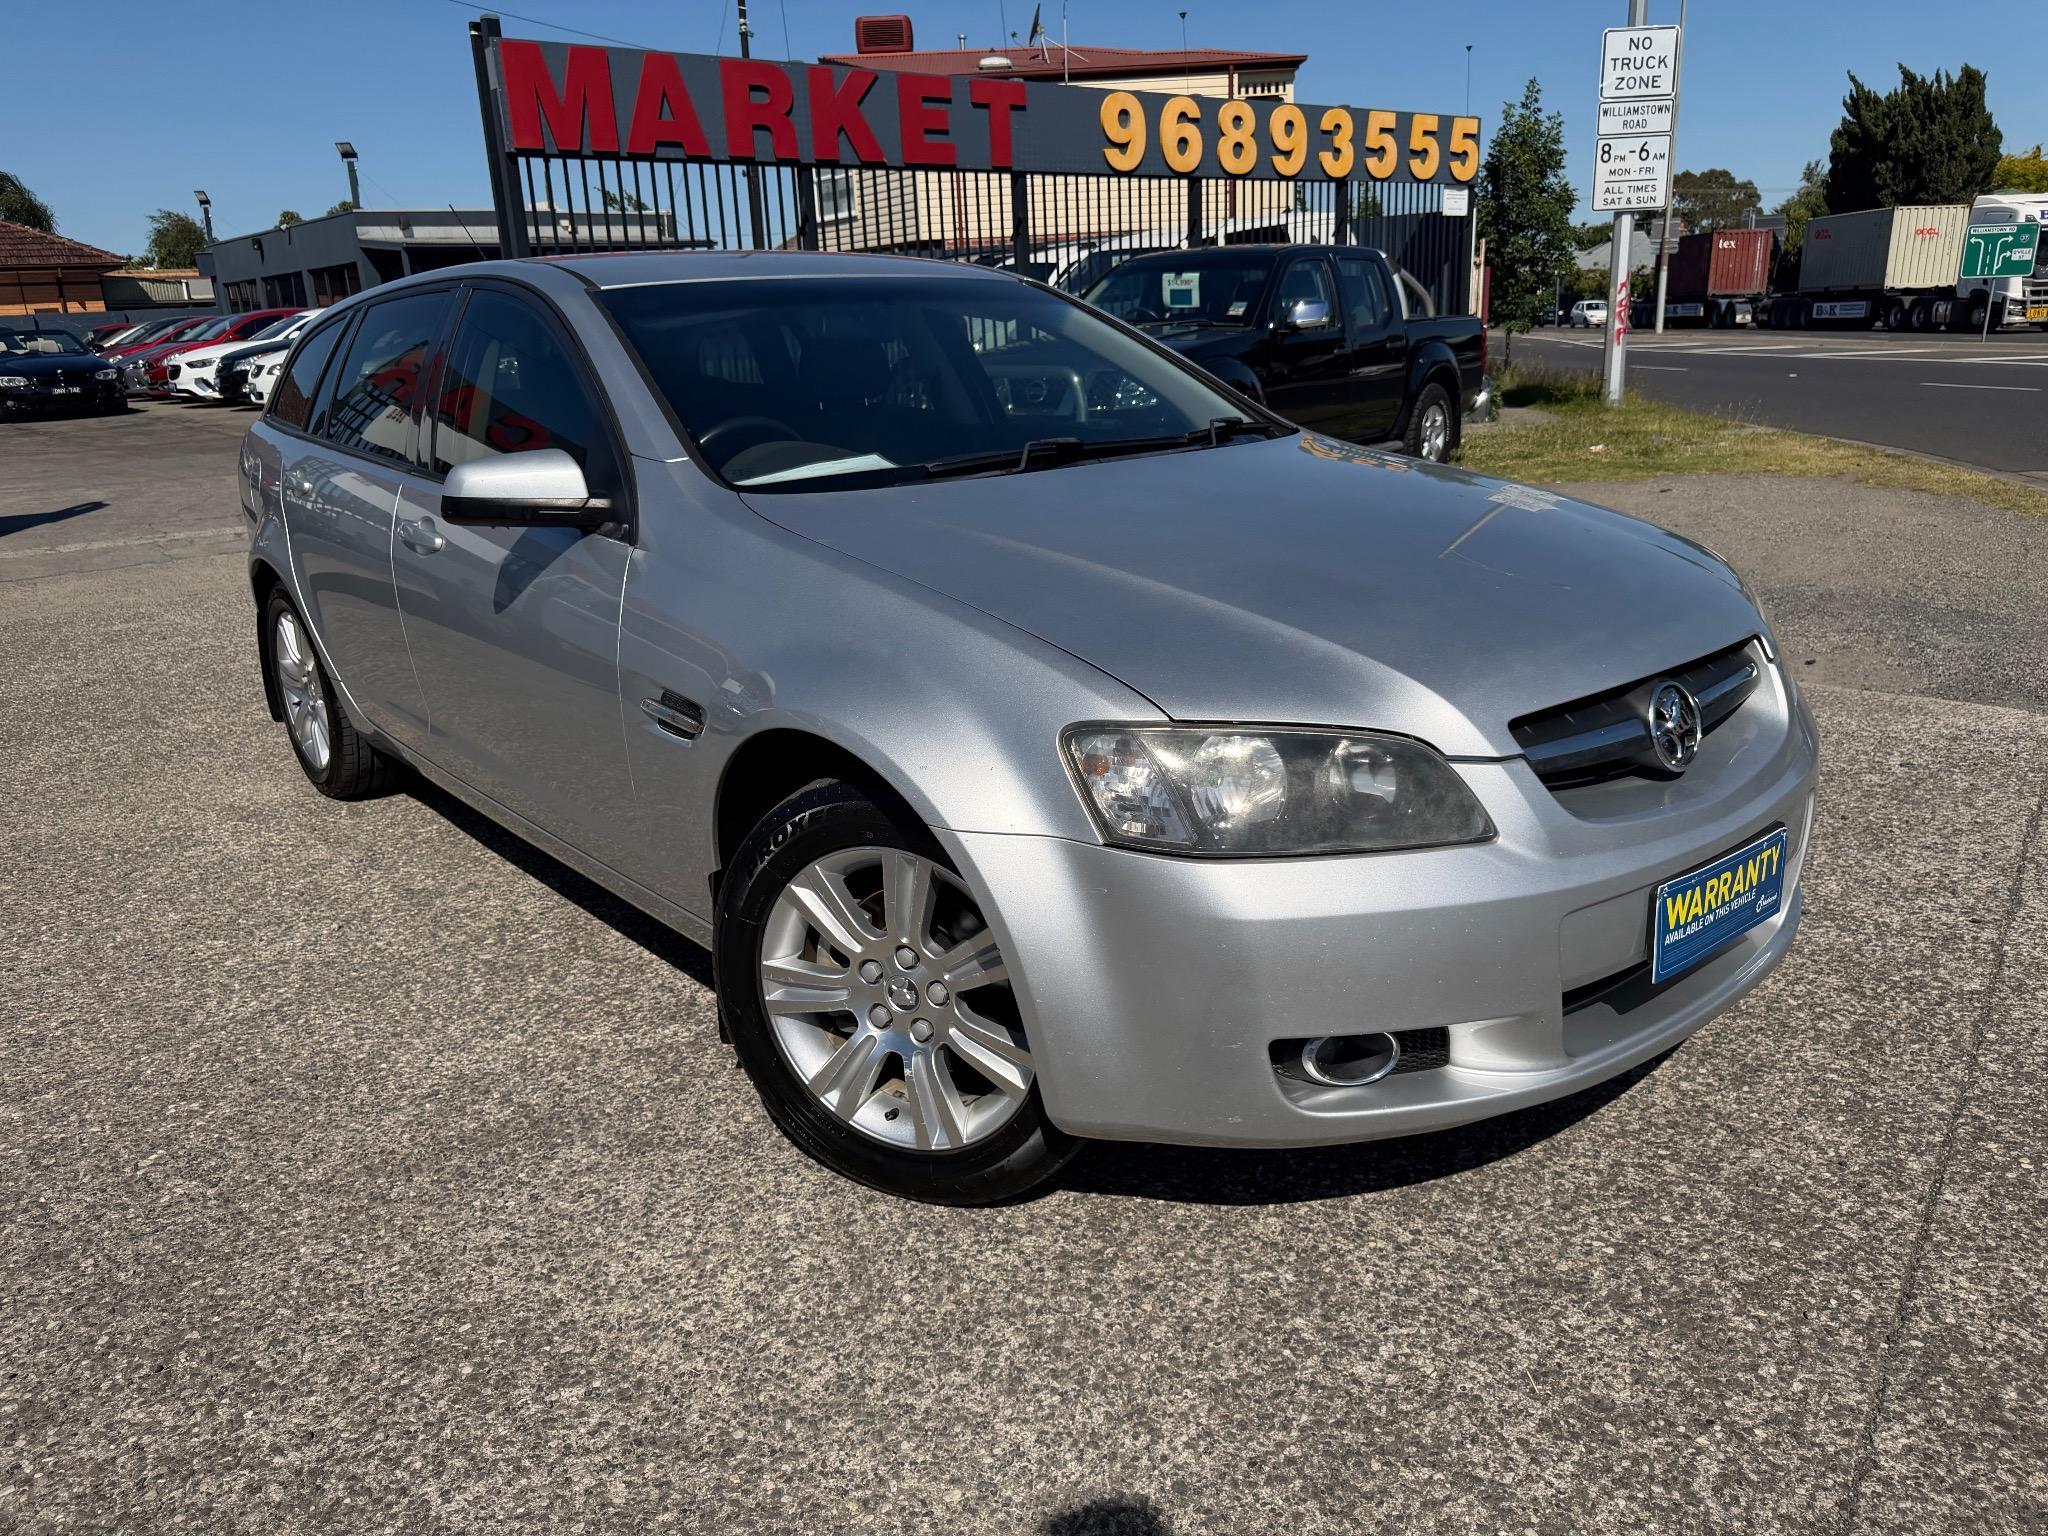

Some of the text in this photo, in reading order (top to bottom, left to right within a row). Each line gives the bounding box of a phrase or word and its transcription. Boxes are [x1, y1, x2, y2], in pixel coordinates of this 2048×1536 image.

[1629, 36, 1653, 51] NO
[1611, 55, 1668, 71] TRUCK
[1615, 75, 1662, 90] ZONE
[497, 38, 1479, 183] MARKET 96893555
[1602, 103, 1671, 117] WILLIAMSTOWN
[1622, 118, 1647, 130] ROAD
[1604, 184, 1657, 195] ALL TIMES
[1602, 195, 1657, 206] SAT & SUN
[1816, 305, 1838, 316] B&K
[1665, 841, 1781, 930] WARRANTY
[1664, 888, 1756, 946] AVAILABLE ON THIS VEHICLE
